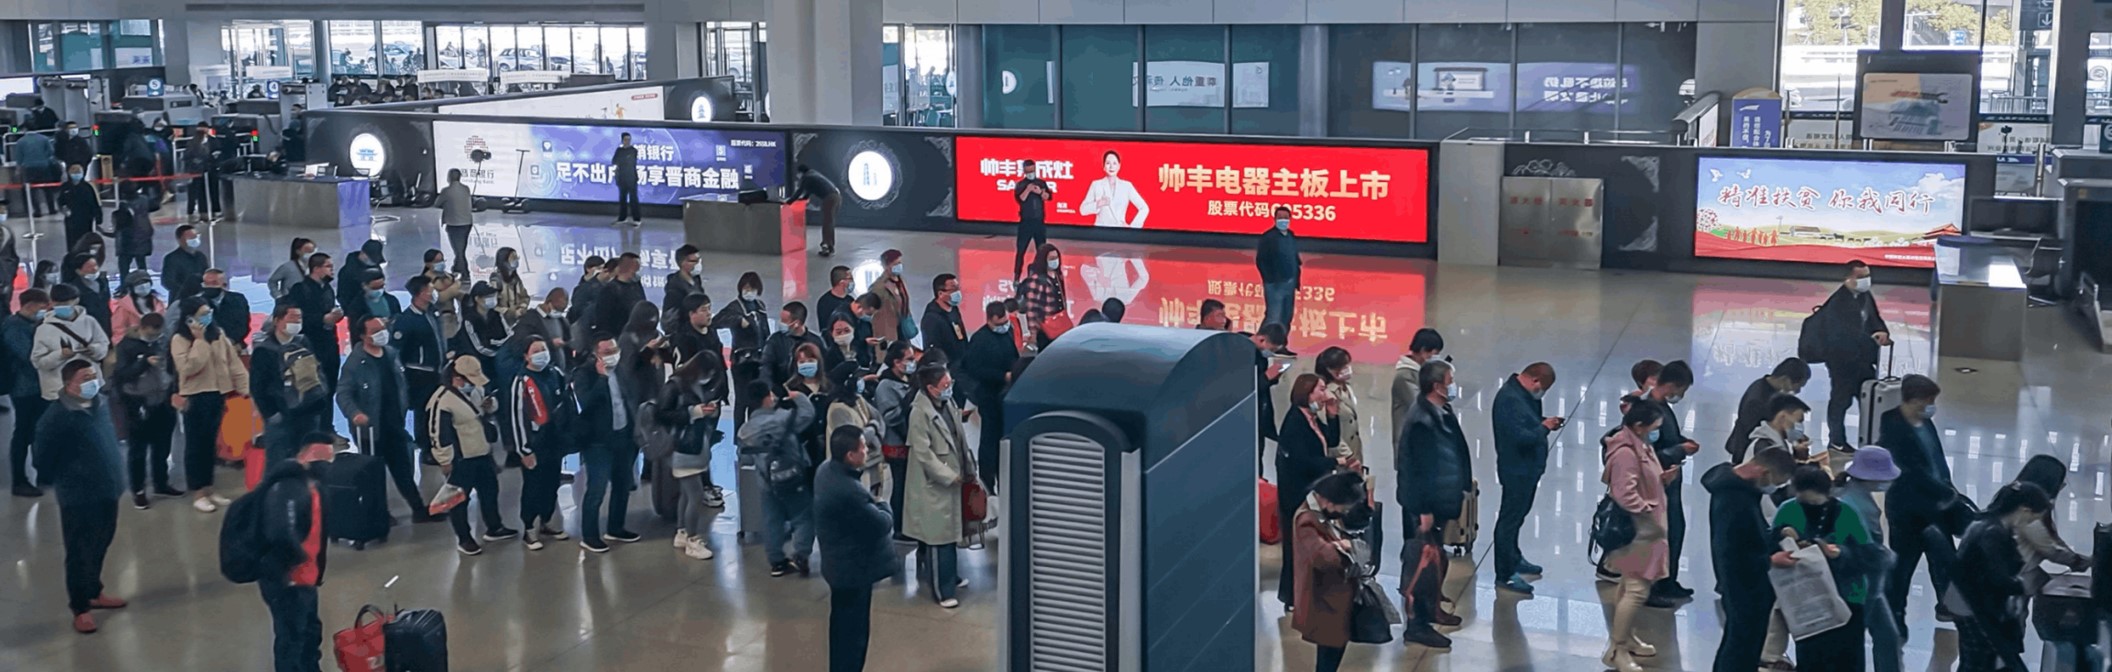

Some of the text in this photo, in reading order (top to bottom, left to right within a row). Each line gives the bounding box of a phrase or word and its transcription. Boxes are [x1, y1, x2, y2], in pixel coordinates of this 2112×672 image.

[1158, 163, 1392, 200] 帅丰电器主板上市
